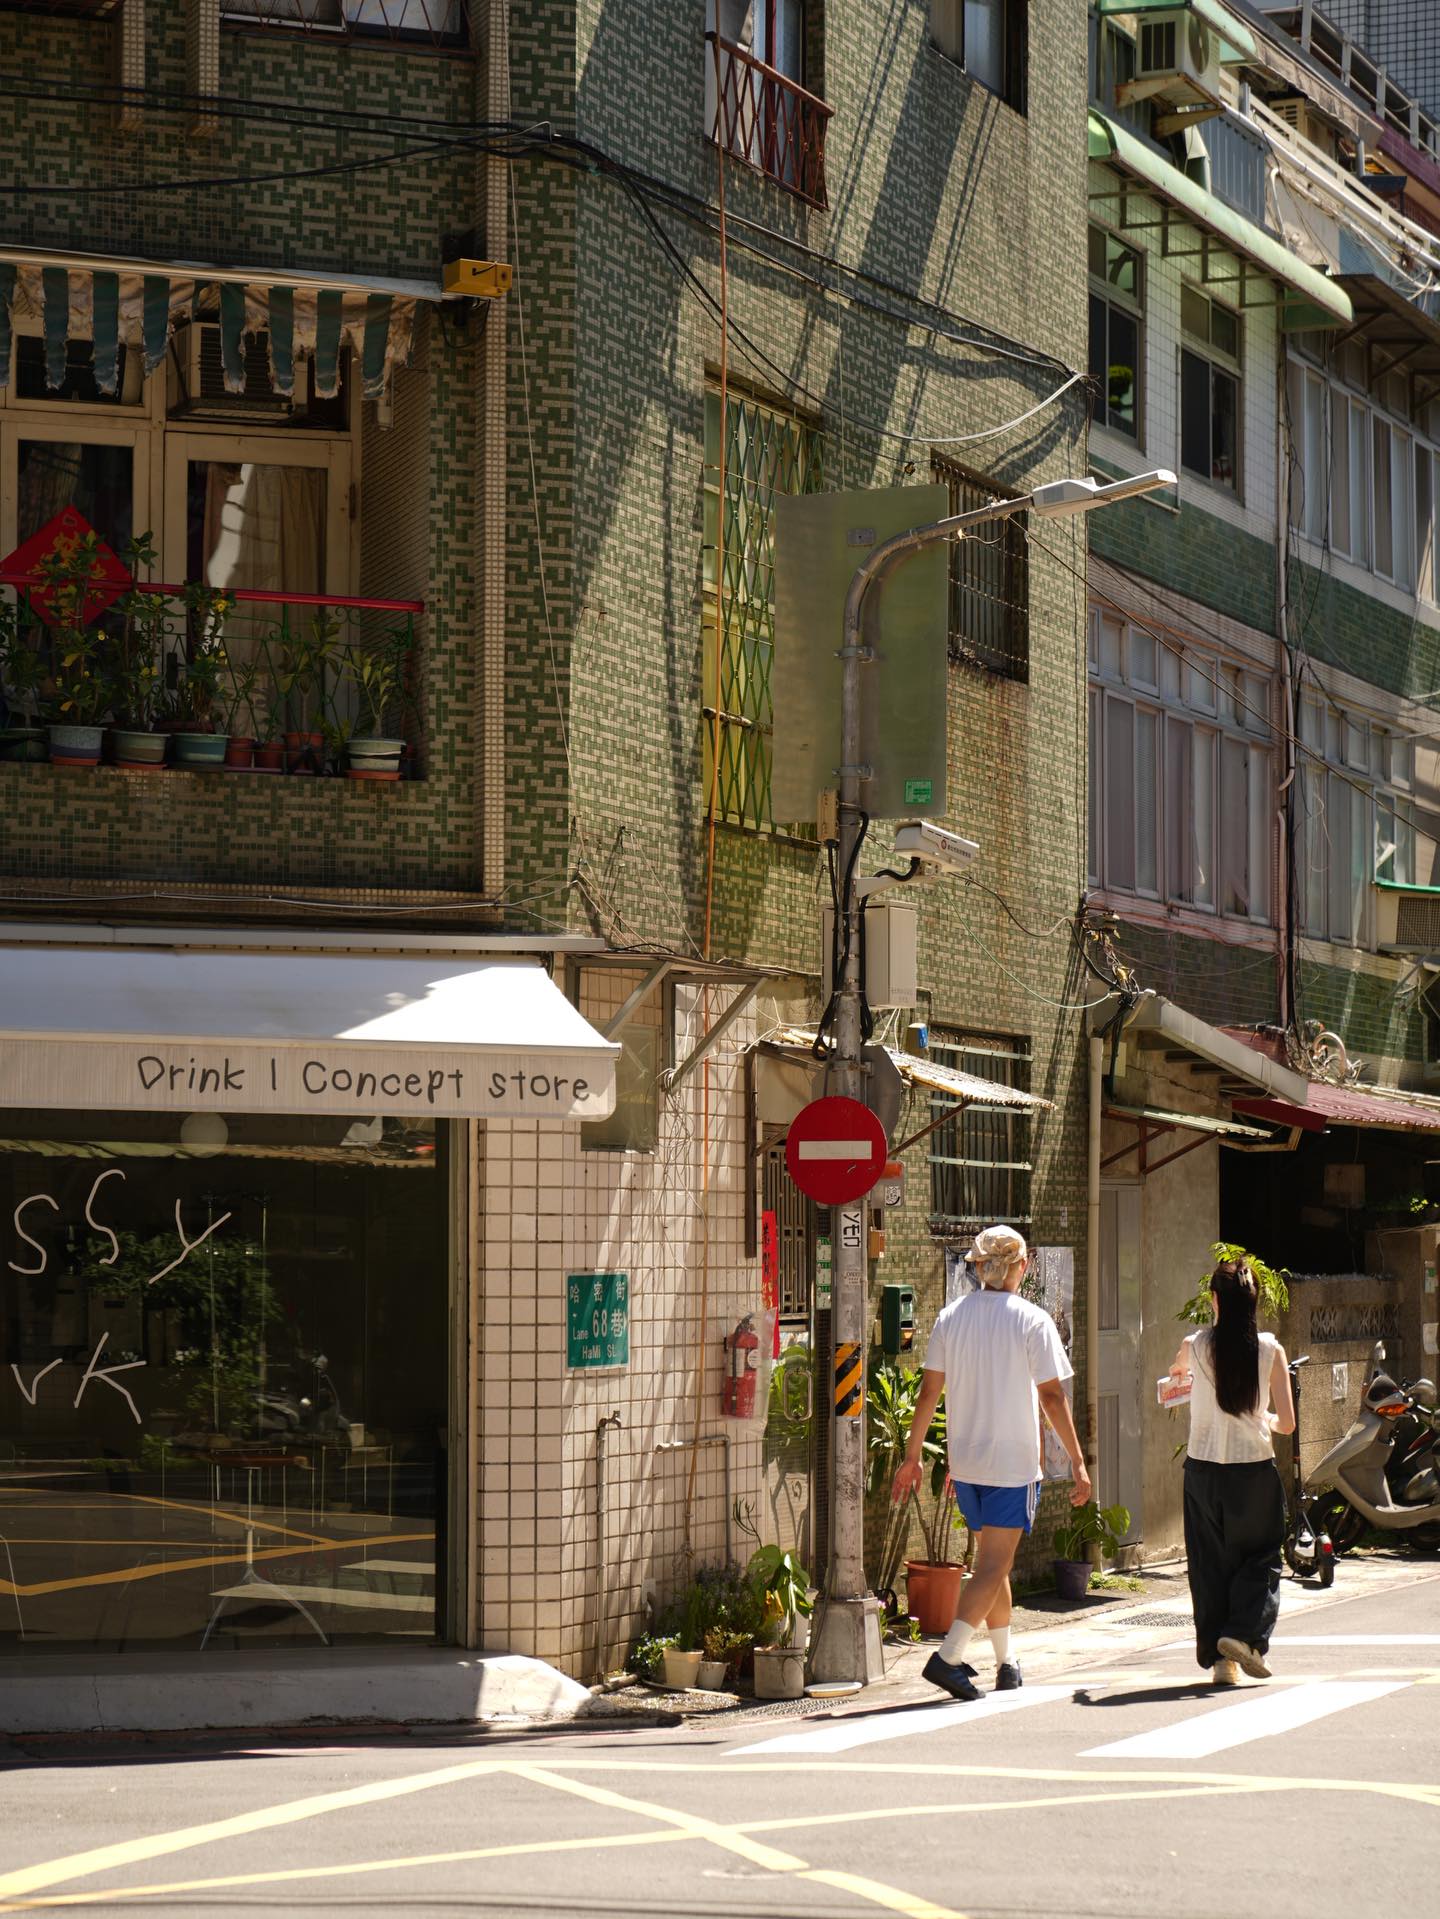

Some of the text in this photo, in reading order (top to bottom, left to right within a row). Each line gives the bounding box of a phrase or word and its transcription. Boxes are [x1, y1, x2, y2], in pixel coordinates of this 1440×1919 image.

[137, 1056, 245, 1093] Drink
[302, 1060, 464, 1104] Concept
[488, 1070, 590, 1101] store
[570, 1281, 625, 1303] 哈密街
[572, 1327, 589, 1340] Lane
[582, 1345, 601, 1359] HaMi
